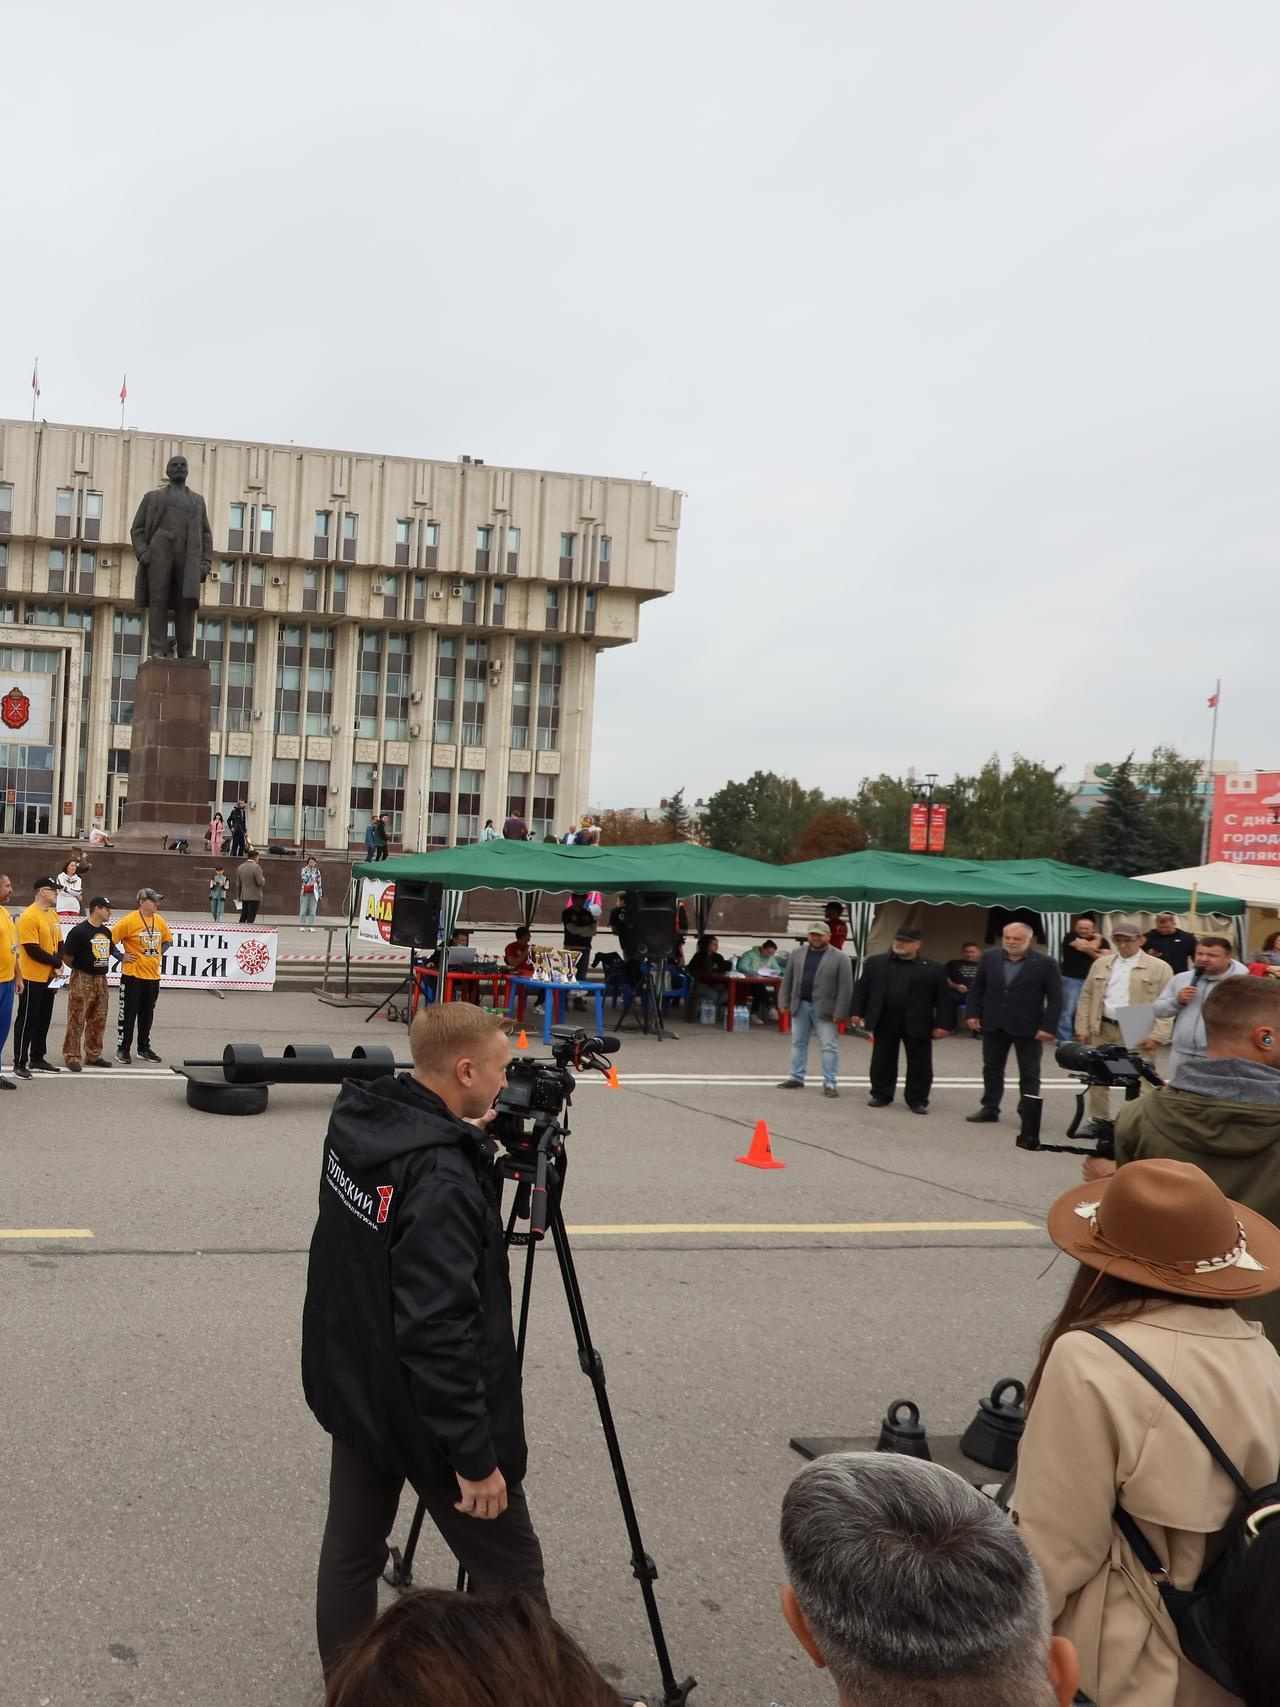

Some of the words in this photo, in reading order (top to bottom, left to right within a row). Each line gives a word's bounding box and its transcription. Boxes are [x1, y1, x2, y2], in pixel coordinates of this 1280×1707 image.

[1224, 813, 1238, 826] С
[1221, 850, 1280, 863] туляк
[170, 932, 229, 950] ЫТЬ
[327, 1154, 373, 1215] ТУЛЬСКИЙ
